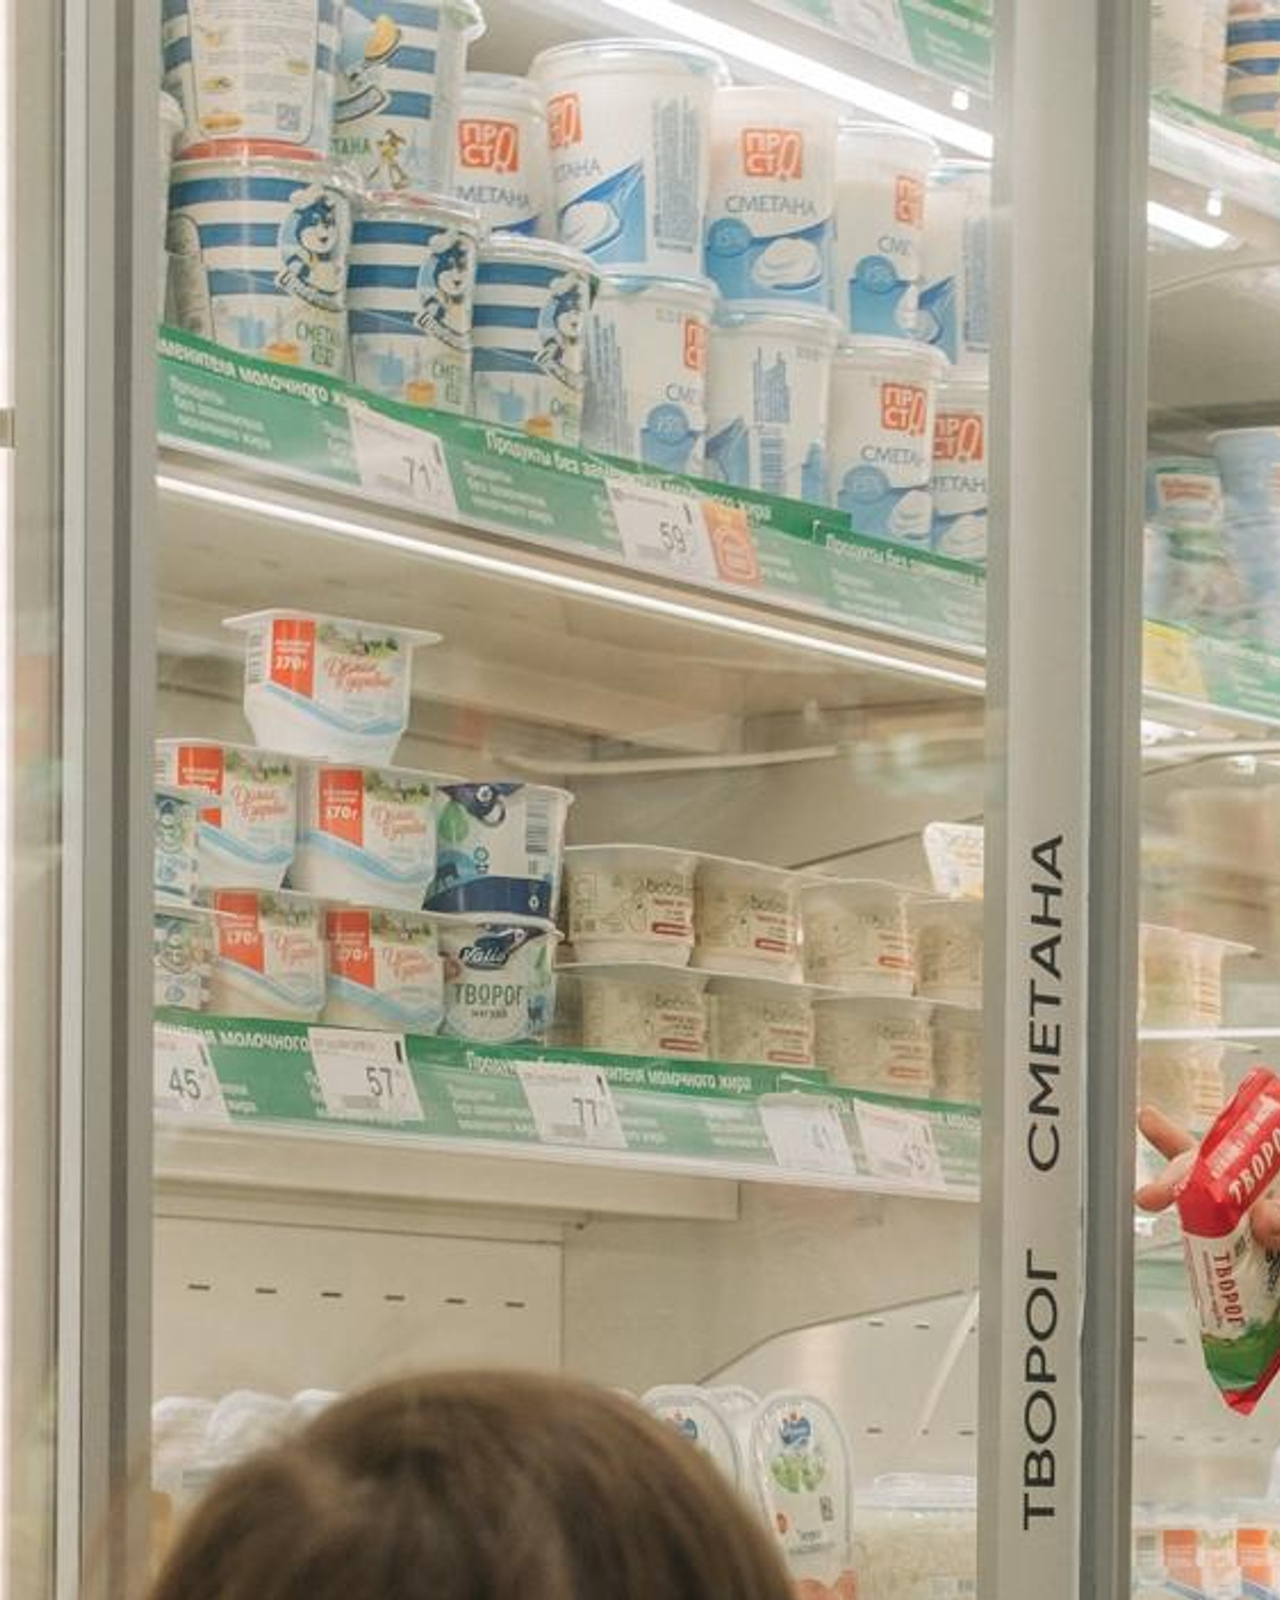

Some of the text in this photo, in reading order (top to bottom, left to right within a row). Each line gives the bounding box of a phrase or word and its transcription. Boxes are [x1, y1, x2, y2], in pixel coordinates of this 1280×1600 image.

[331, 138, 371, 153] ТАНА
[725, 194, 816, 216] СМЕТАНА
[659, 521, 688, 553] 59
[454, 983, 523, 1007] ТВОРОГ
[219, 1030, 308, 1053] молочного
[169, 1066, 202, 1100] 45
[365, 1066, 394, 1098] 57
[1023, 835, 1064, 1531] ТВОРОГ СМЕТАНА
[1213, 1251, 1246, 1327] ТВОРОГ
